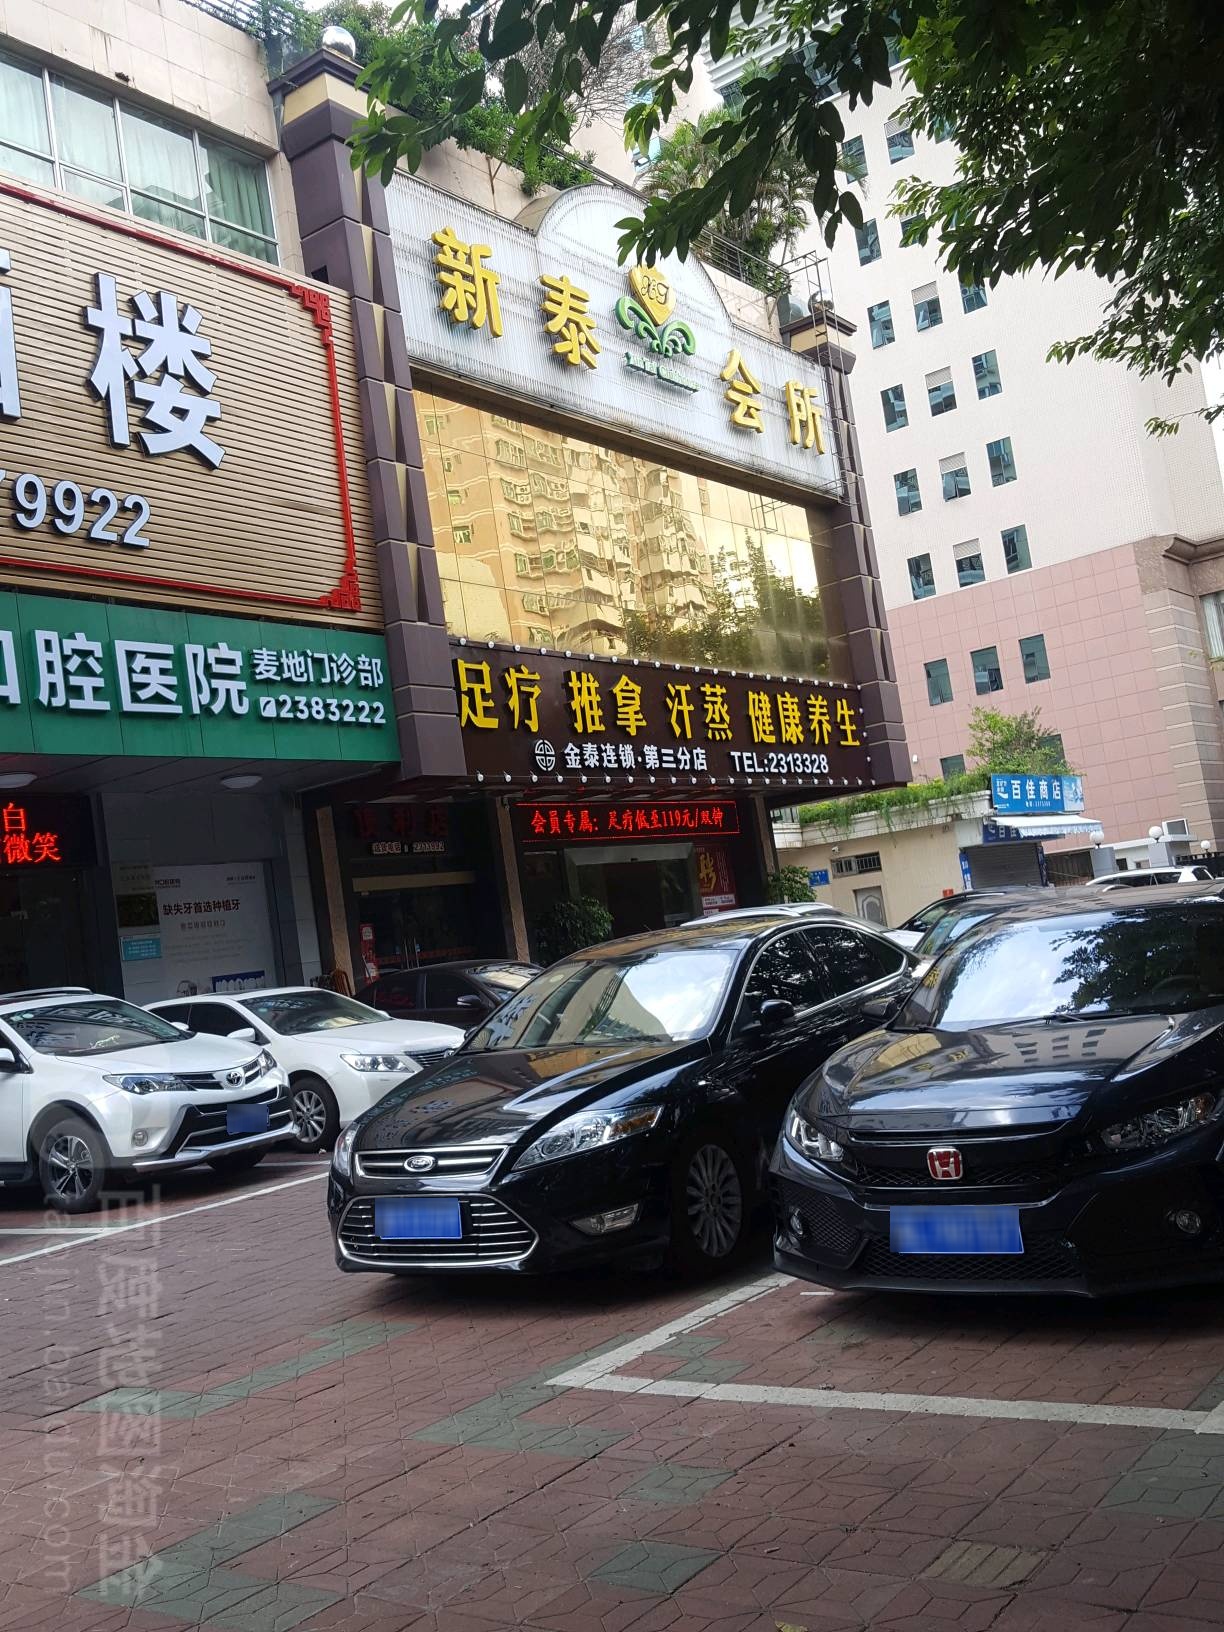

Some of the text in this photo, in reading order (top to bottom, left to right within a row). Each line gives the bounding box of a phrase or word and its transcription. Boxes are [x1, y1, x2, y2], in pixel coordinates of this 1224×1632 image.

[0, 250, 227, 469] 楼
[0, 468, 151, 547] 9922
[251, 647, 385, 688] 麦地门诊部
[278, 694, 386, 725] 2383222
[748, 689, 861, 747] 健康养生
[731, 751, 830, 774] TEL:2313328
[1011, 779, 1062, 800] 百佳商店
